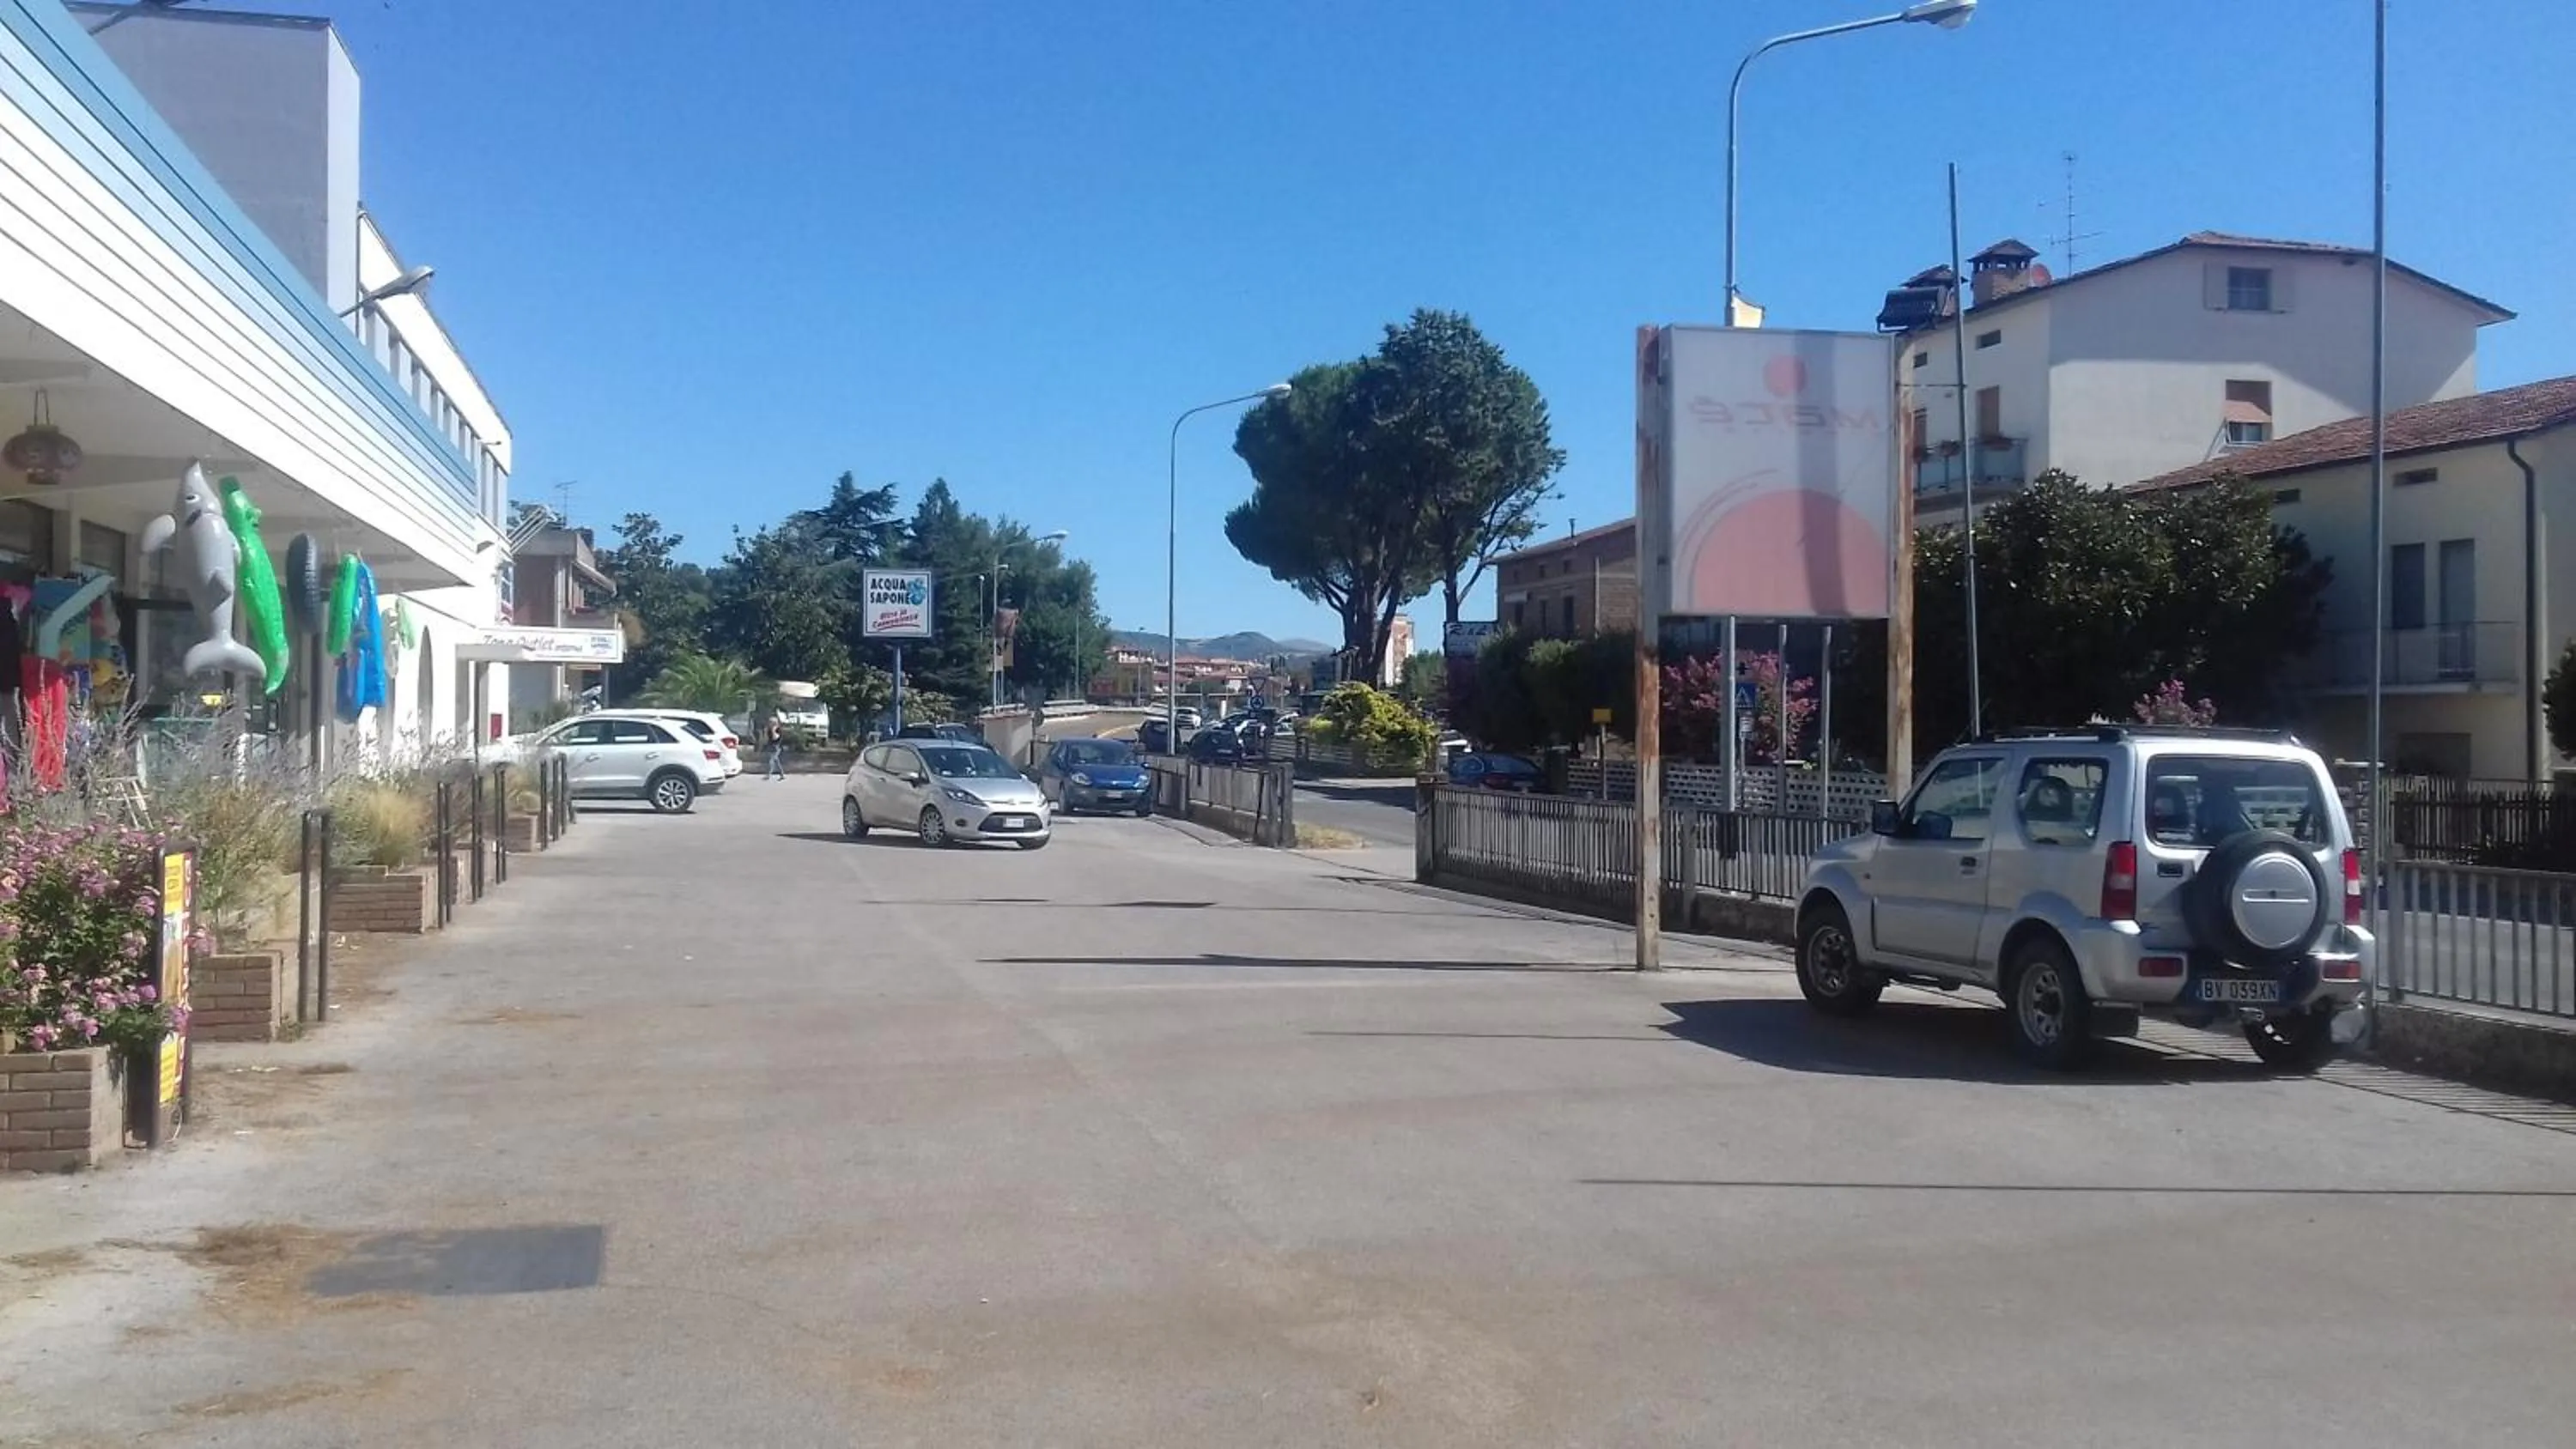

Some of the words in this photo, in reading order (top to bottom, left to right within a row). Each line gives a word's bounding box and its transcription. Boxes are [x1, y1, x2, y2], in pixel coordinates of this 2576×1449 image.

[870, 578, 906, 590] ACQUA
[870, 592, 910, 604] SAPONE
[2204, 981, 2222, 997] BV
[2230, 982, 2276, 999] 039XN
